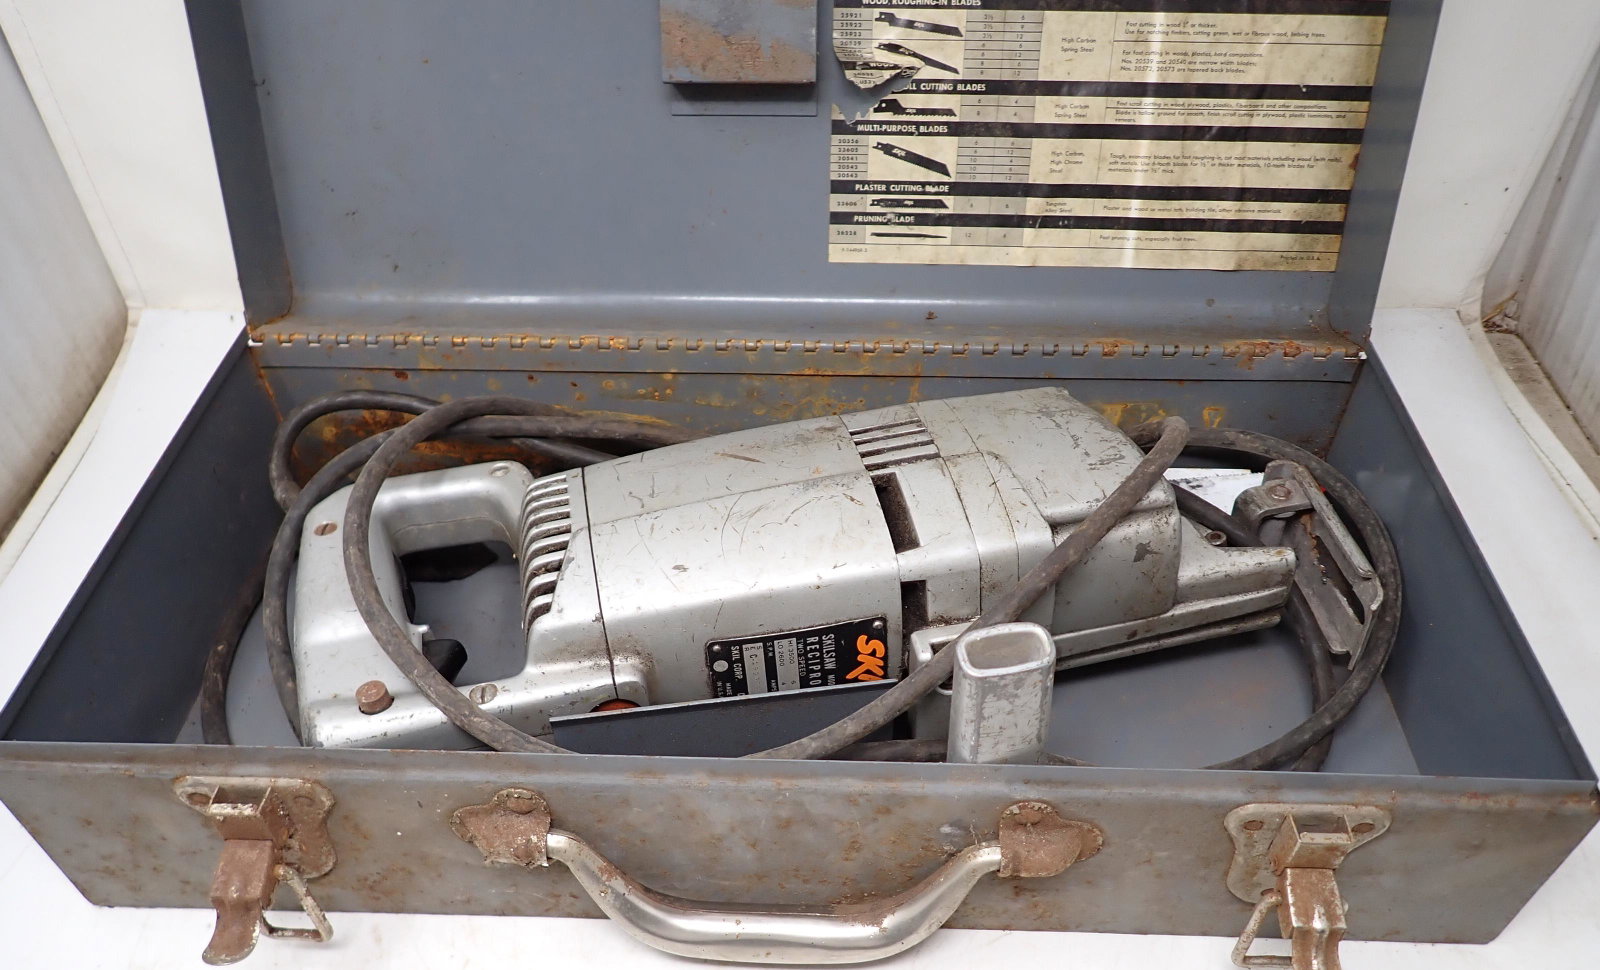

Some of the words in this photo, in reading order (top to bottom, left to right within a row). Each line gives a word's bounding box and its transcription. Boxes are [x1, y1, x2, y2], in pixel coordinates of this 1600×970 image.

[920, 83, 954, 91] CUTTING
[956, 83, 986, 91] BLADES
[857, 124, 917, 133] MULTI-PURPOSE
[919, 125, 948, 133] BLADES
[855, 183, 887, 192] PLASTER
[890, 184, 922, 192] CUTTING
[925, 184, 950, 193] BLADE
[853, 215, 887, 223] PRUNING
[891, 215, 915, 223] BLADE
[777, 641, 784, 649] LO
[797, 638, 805, 654] TWO
[822, 633, 837, 669] SKILSAW
[731, 645, 741, 661] SKIL
[806, 636, 822, 685] RECIPRO
[733, 663, 744, 682] CORP.
[798, 656, 807, 677] SPEED
[725, 682, 733, 696] MADE
